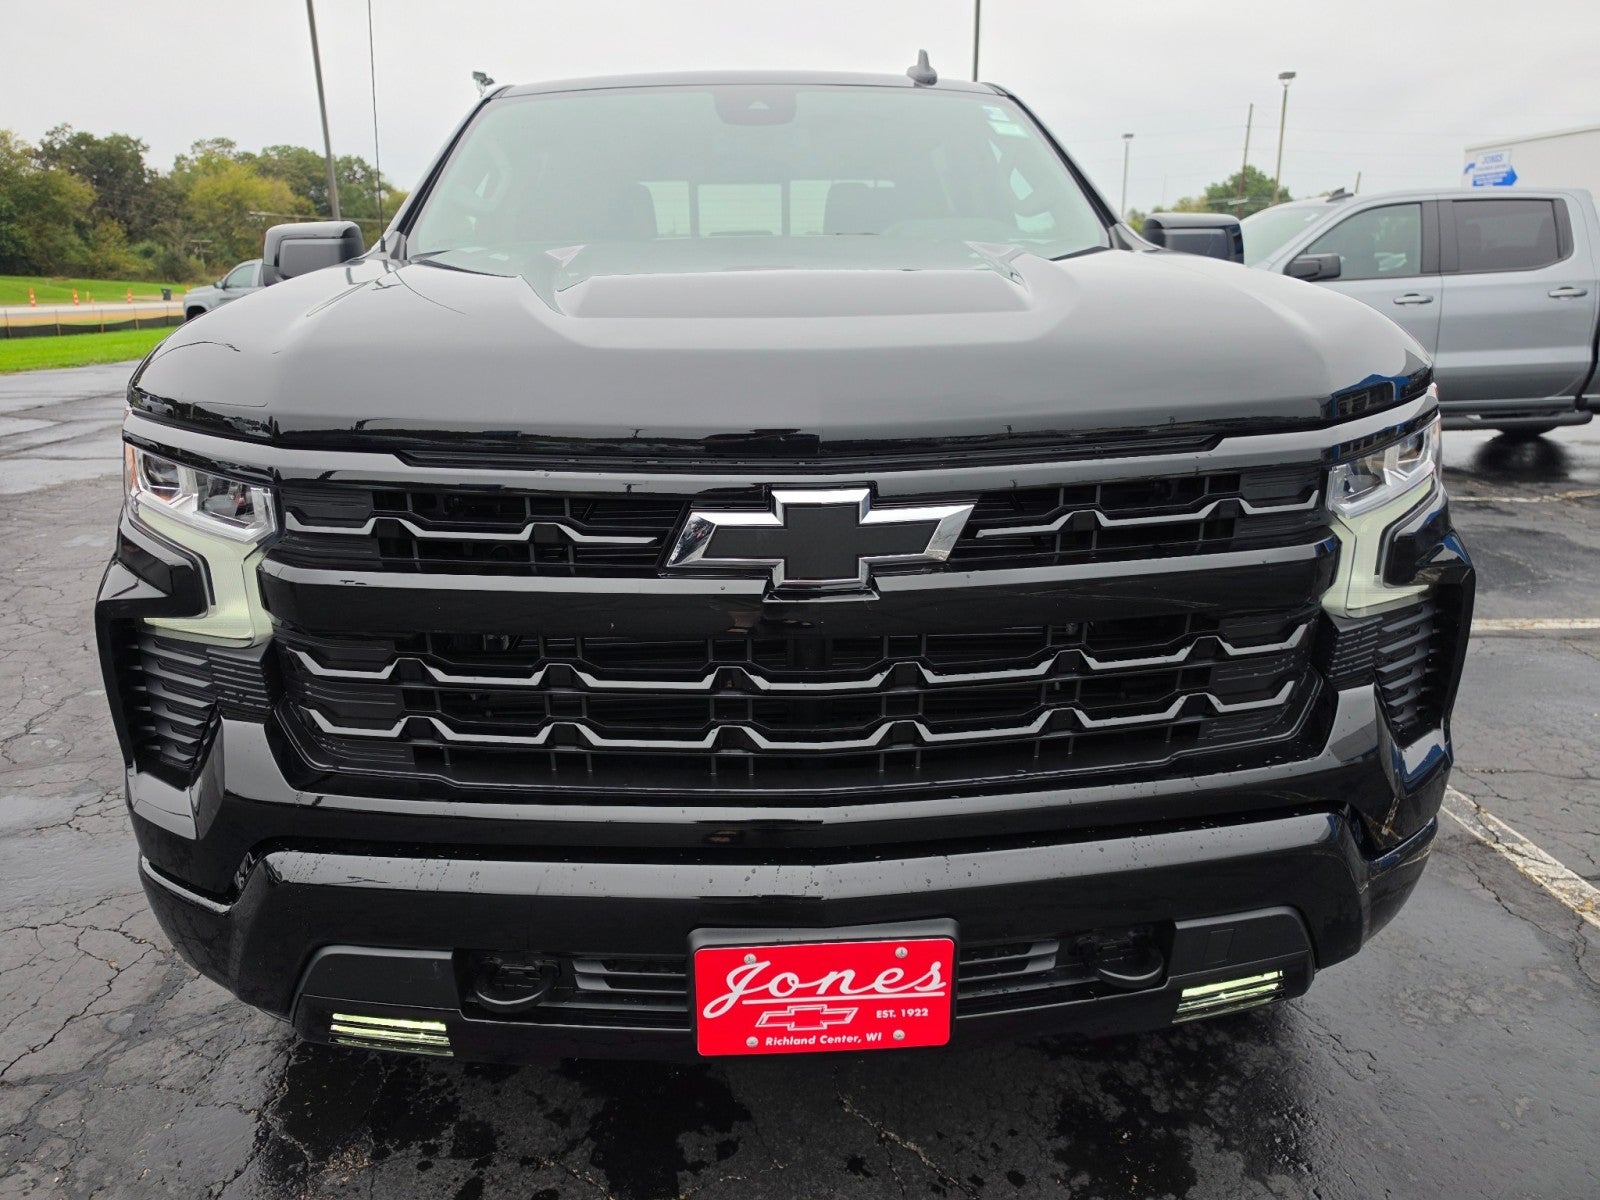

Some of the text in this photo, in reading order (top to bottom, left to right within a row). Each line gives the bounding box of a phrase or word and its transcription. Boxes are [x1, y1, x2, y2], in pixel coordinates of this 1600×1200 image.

[703, 960, 946, 1019] Jones
[876, 1008, 929, 1018] EST. 1922
[765, 1032, 882, 1047] Richland Center, WI
